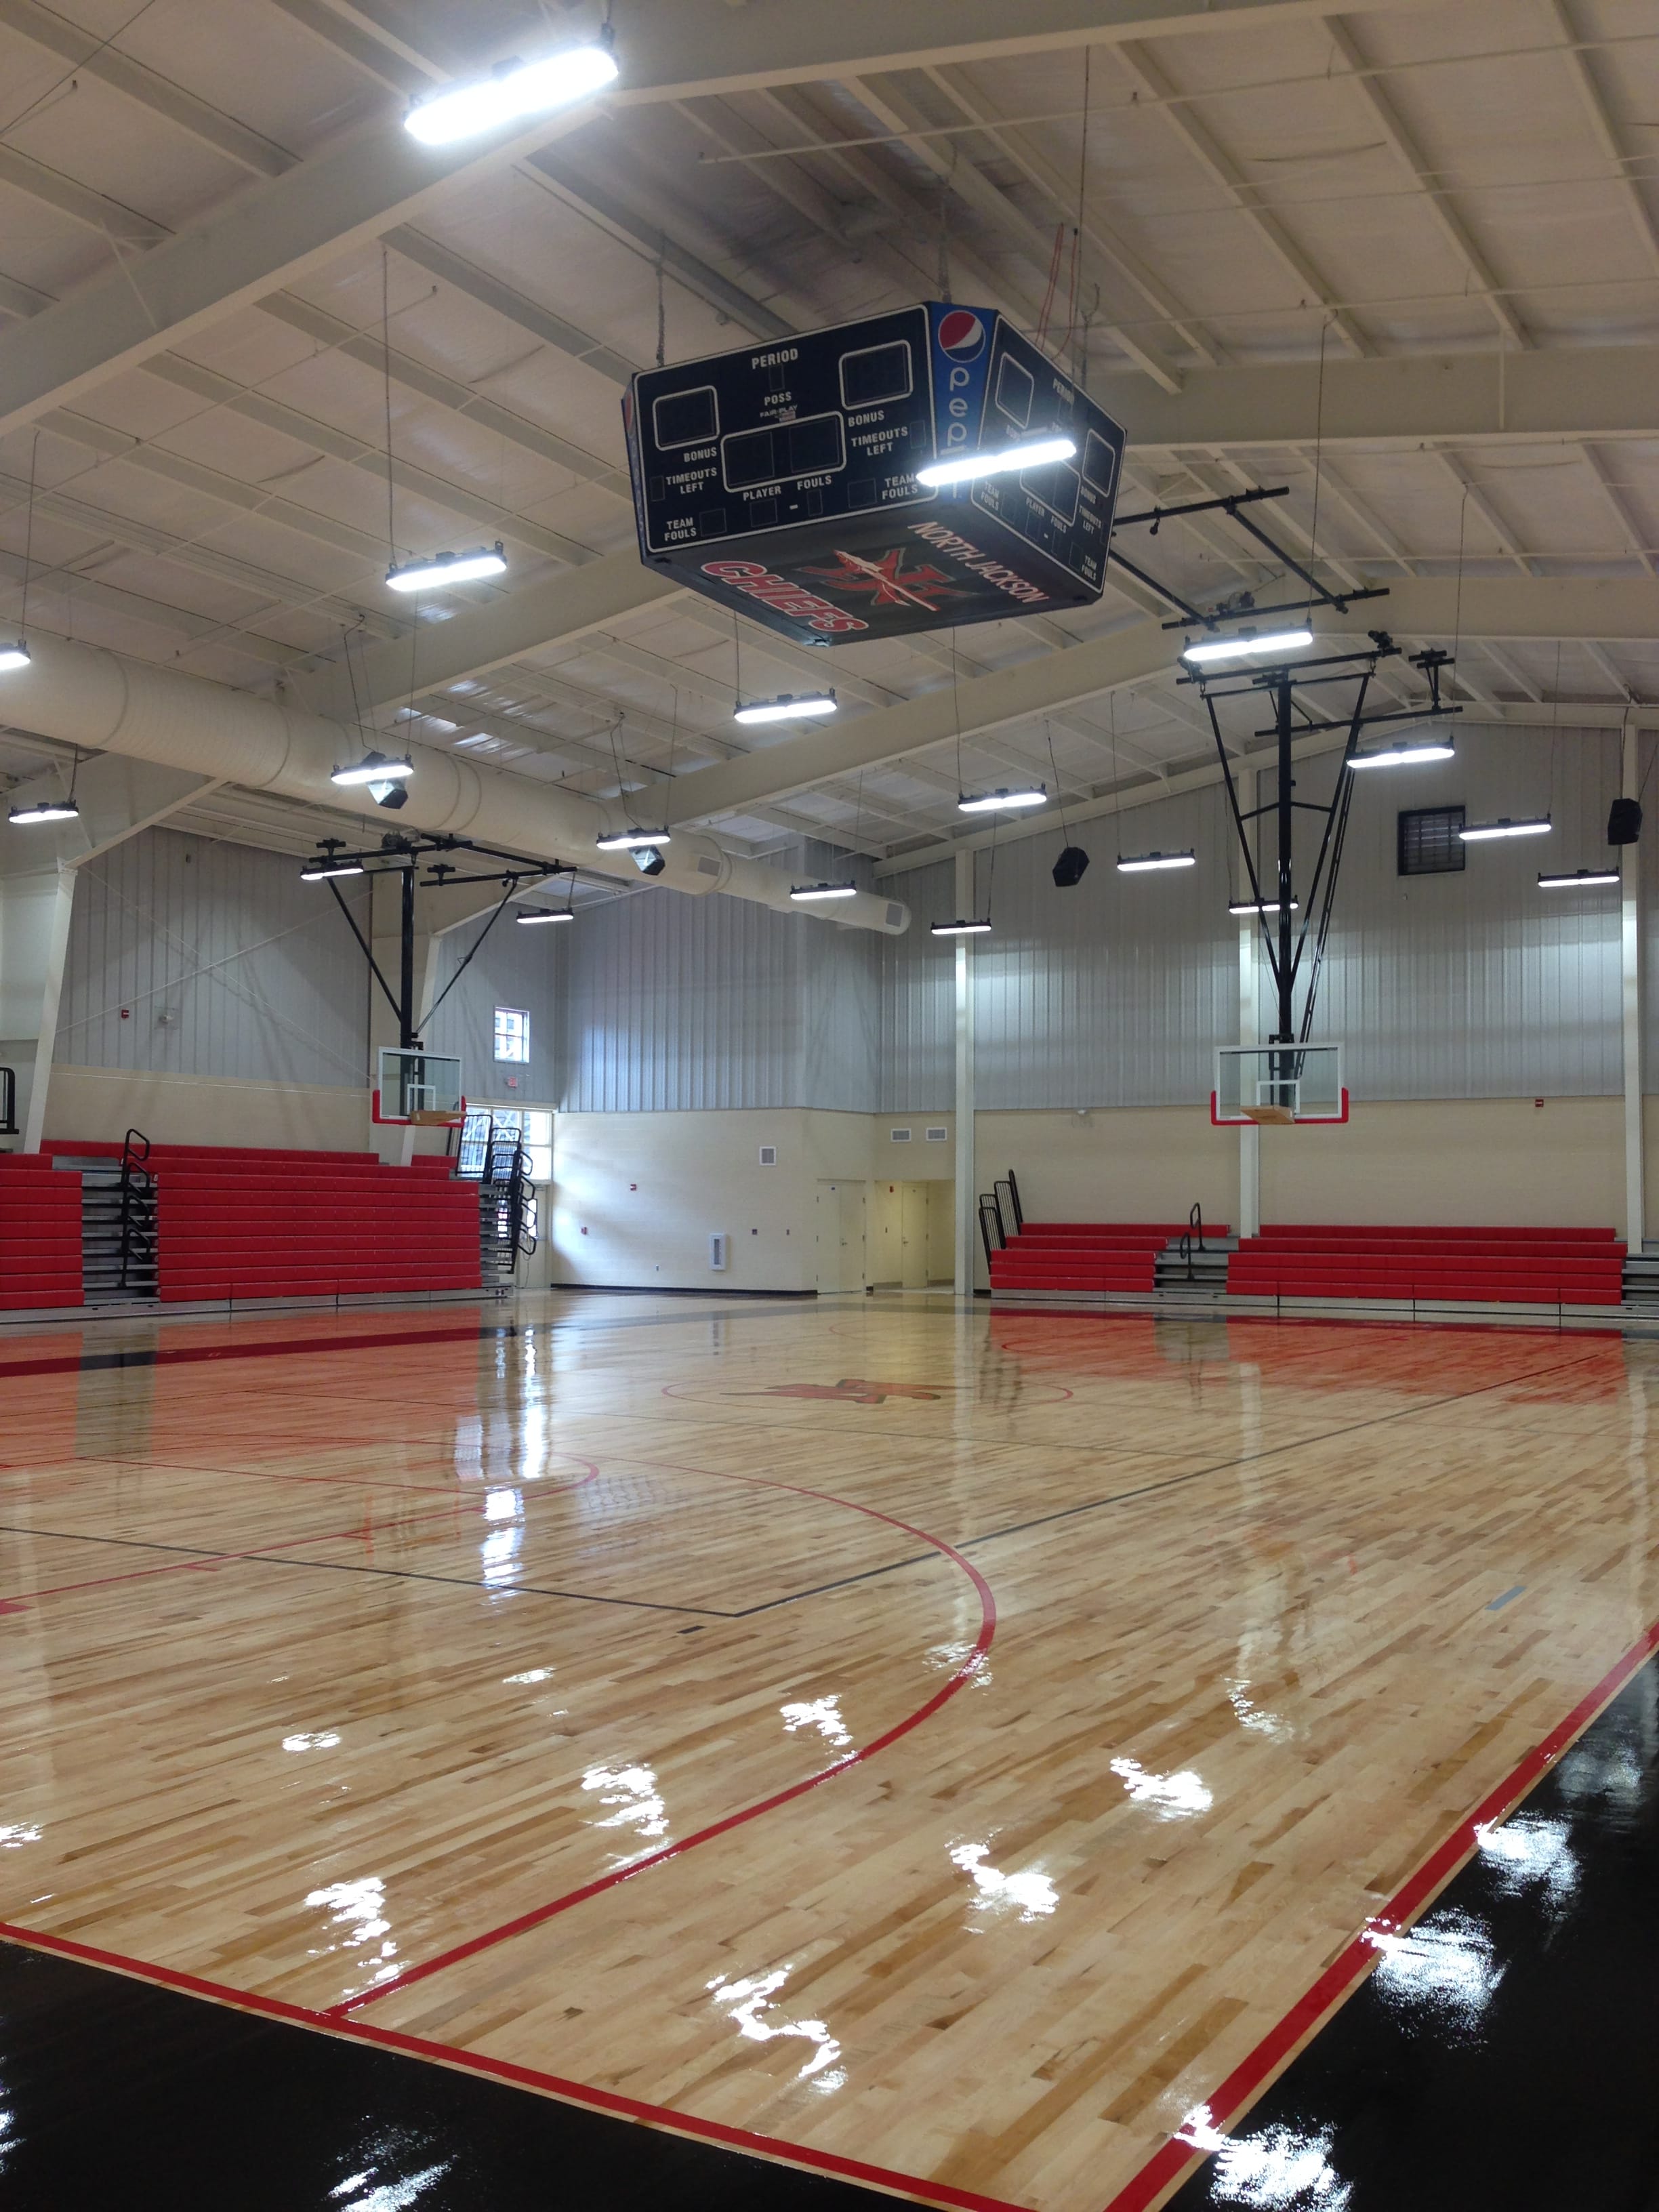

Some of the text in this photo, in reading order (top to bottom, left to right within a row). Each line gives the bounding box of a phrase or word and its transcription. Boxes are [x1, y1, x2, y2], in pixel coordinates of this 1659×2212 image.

[752, 348, 798, 369] PERIOD
[764, 392, 792, 406] POSS
[848, 410, 884, 427] BONUS
[851, 426, 908, 447] TIMEOUTS
[947, 367, 970, 499] pepi
[683, 447, 718, 462] BONUS
[867, 442, 893, 456] LEFT
[665, 467, 717, 485] TIMEOUTS
[884, 473, 915, 487] TEAM
[680, 482, 704, 494] LEFT
[743, 475, 832, 501] PLAYER FOULS
[882, 484, 918, 499] FOULS
[667, 517, 694, 530] TEAM
[1083, 520, 1094, 535] LEFT
[664, 527, 697, 541] FOULS
[907, 521, 1050, 604] NORTH JACKSON
[701, 560, 869, 632] CHIEFS
